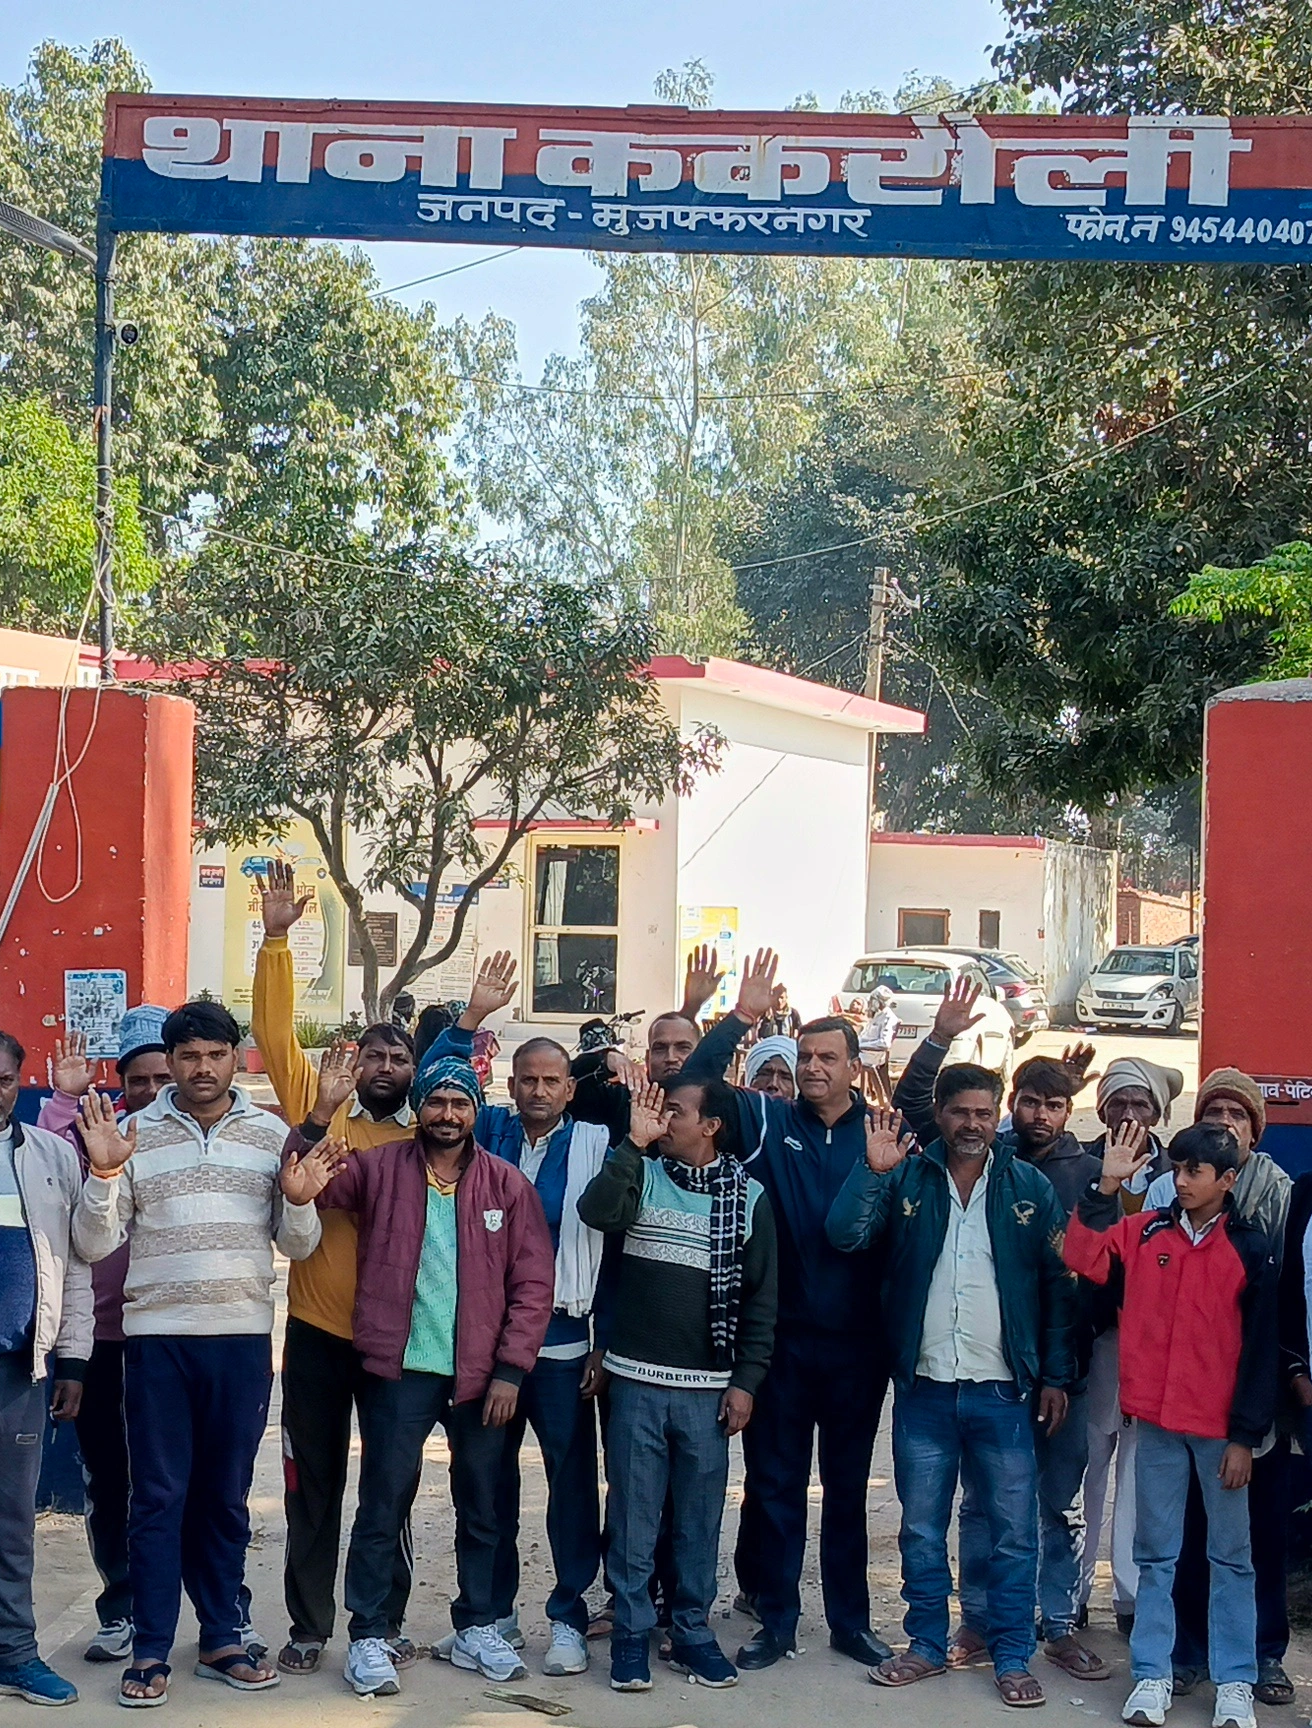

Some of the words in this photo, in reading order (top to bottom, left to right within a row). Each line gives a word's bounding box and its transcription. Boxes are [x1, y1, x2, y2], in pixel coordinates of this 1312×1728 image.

[142, 116, 516, 191] थाना
[417, 193, 566, 229] जनपद
[592, 203, 872, 237] मुजफ्फरनगर
[637, 1366, 710, 1383] BURBERRY
